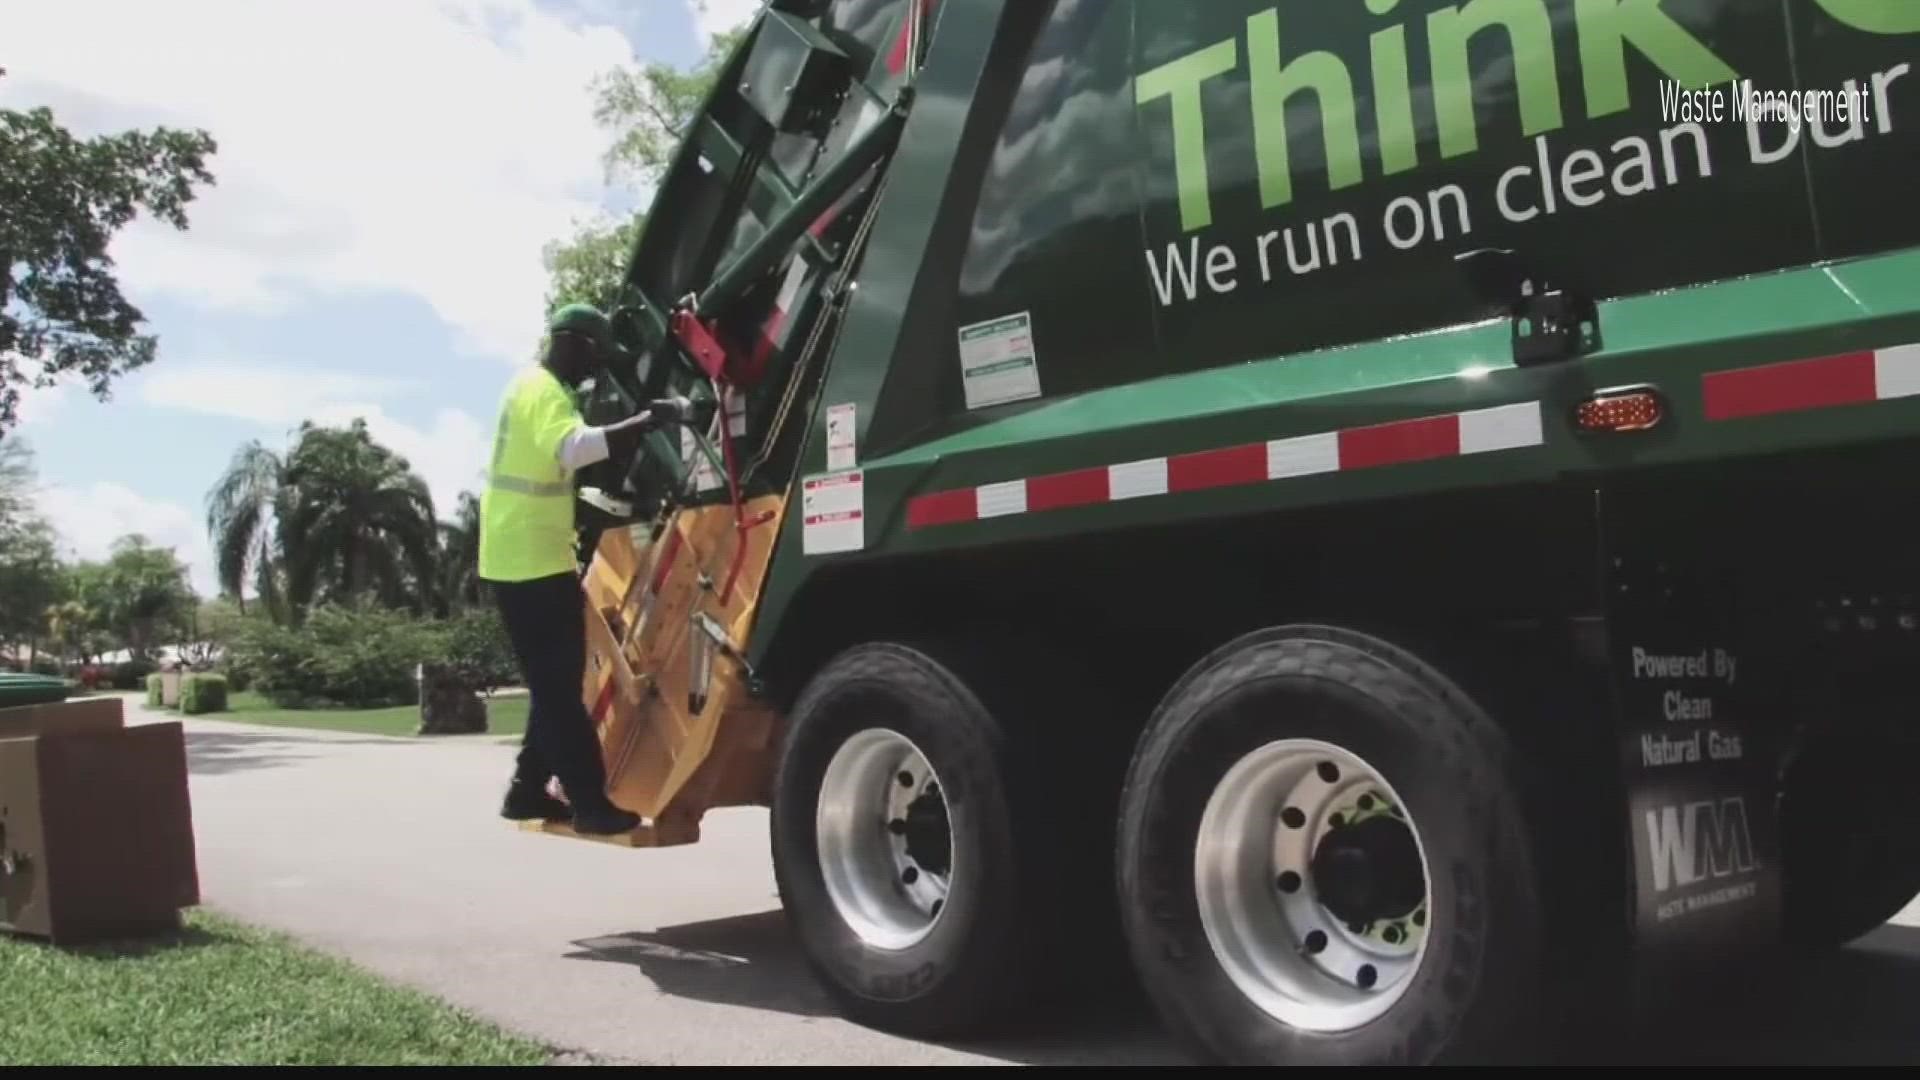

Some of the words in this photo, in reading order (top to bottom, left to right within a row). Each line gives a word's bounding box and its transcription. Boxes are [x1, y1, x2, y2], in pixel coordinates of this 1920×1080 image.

[1136, 0, 1740, 231] Think
[1145, 236, 1237, 306] We
[1257, 212, 1362, 282] run
[1383, 184, 1472, 249] on
[1496, 121, 1712, 222] clean
[1632, 646, 1707, 678] Powered
[1714, 649, 1736, 685] By
[1663, 689, 1712, 721] Clean
[1641, 730, 1701, 767] Natural
[1708, 730, 1743, 760] Gas
[1646, 796, 1755, 892] WM
